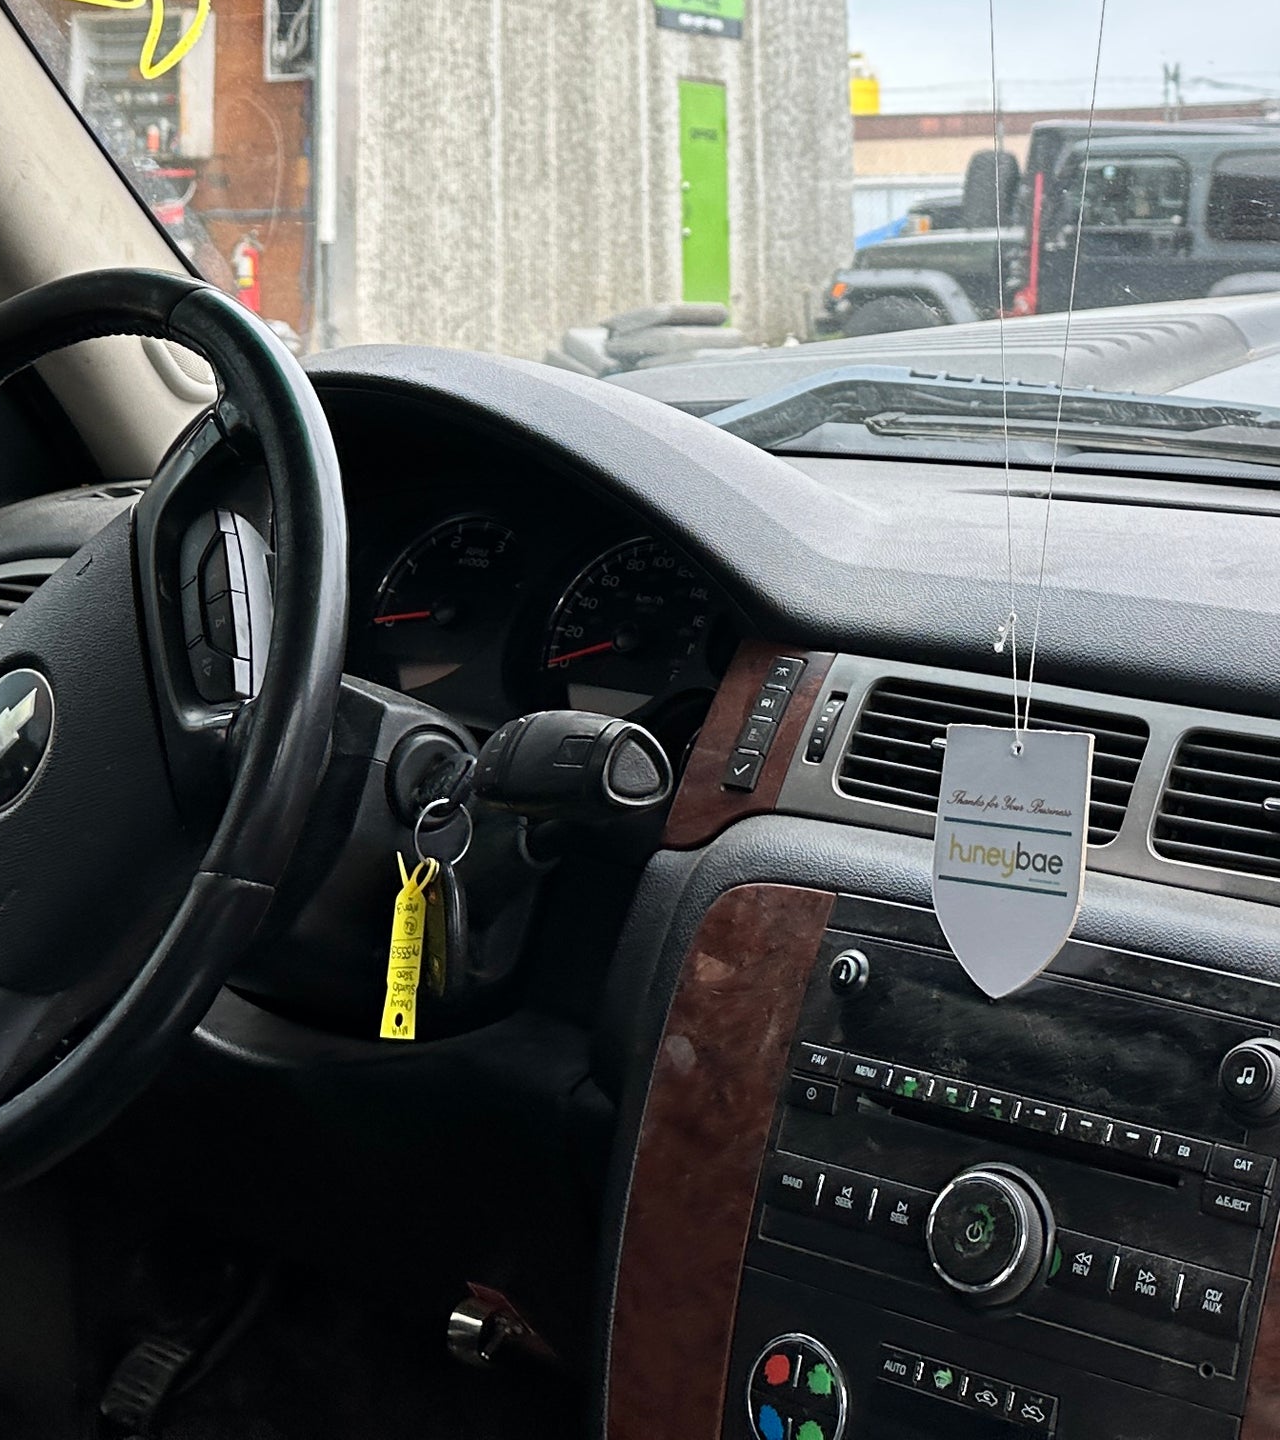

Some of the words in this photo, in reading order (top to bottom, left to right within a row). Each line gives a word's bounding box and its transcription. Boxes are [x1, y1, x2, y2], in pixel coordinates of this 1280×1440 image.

[601, 574, 620, 588] 60
[579, 596, 598, 610] 40
[564, 625, 584, 639] 20
[946, 789, 985, 808] Thanks
[982, 794, 999, 811] for
[1000, 796, 1024, 812] Your
[1027, 798, 1072, 817] Business
[811, 1054, 827, 1066] FAV
[855, 1064, 877, 1078] MENU
[1177, 1145, 1191, 1157] EQ
[1233, 1158, 1253, 1172] CAT
[781, 1174, 803, 1190] BAND
[835, 1196, 854, 1209] SEEK
[1223, 1197, 1252, 1212] EJECT
[890, 1212, 908, 1226] SEEK
[1072, 1263, 1090, 1277] REV
[1135, 1283, 1156, 1296] FWD
[1202, 1300, 1222, 1314] AUX
[883, 1359, 907, 1376] AUTO
